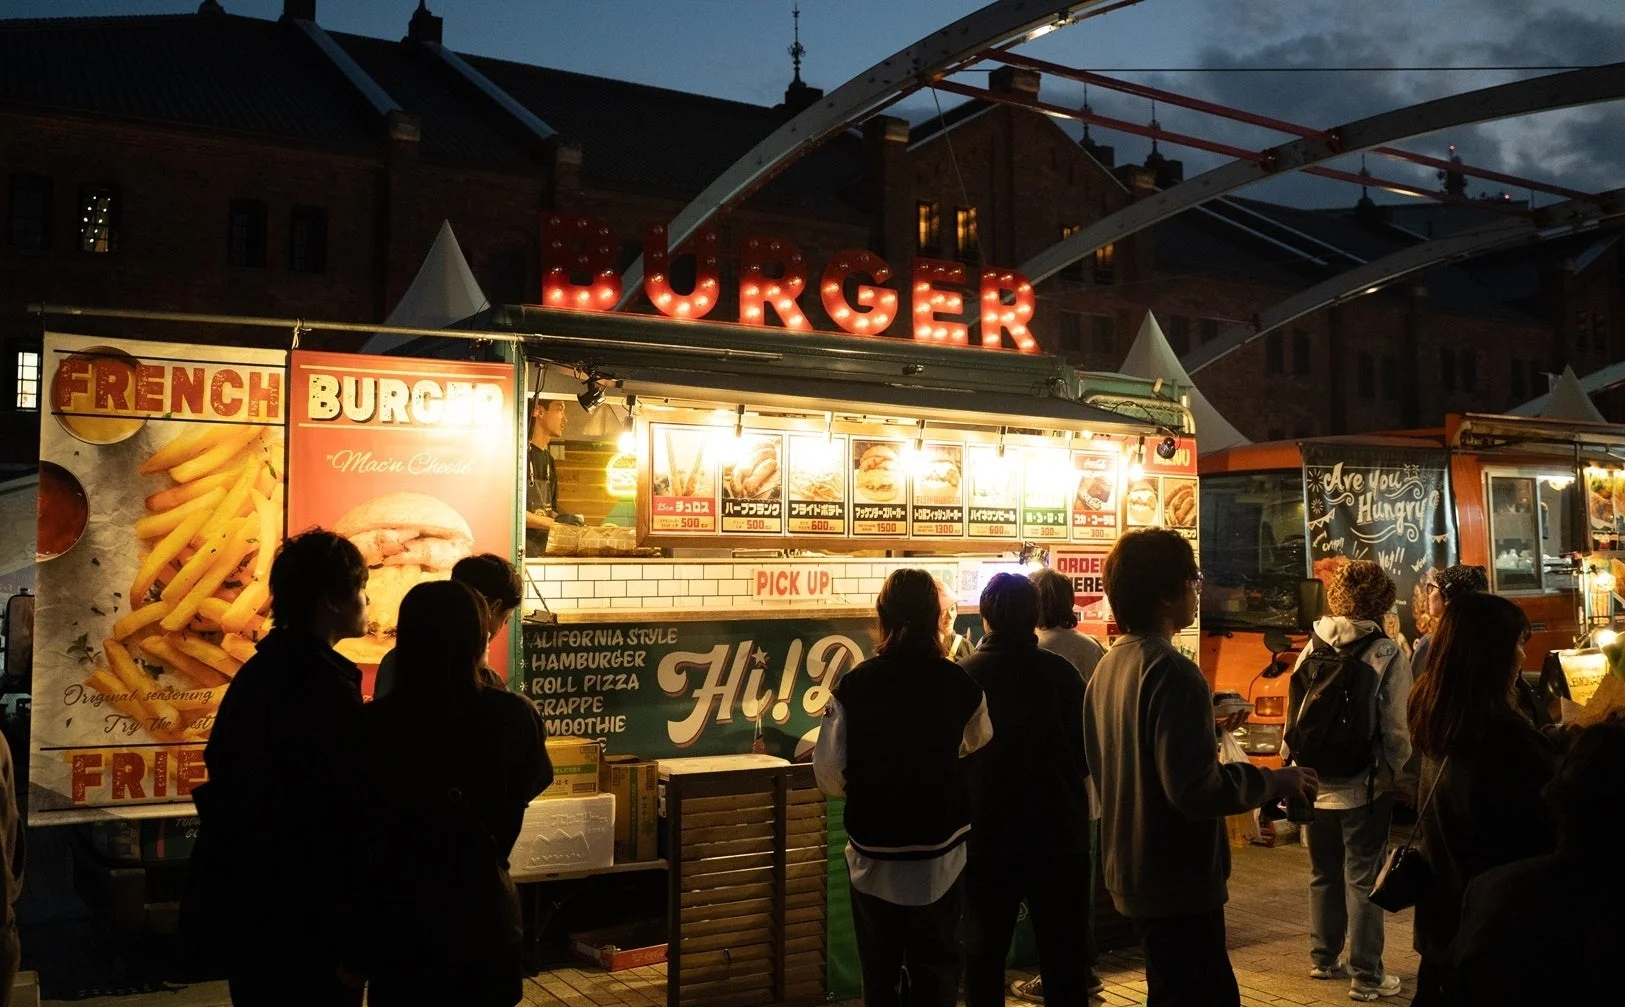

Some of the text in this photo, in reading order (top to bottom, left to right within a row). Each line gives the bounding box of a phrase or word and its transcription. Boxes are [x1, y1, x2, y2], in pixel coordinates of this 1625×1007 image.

[541, 213, 1040, 354] BURGER
[56, 357, 281, 418] FRENCH
[308, 373, 504, 424] BURGER
[1323, 461, 1402, 500] Are you
[675, 500, 710, 513] チュロス
[791, 503, 843, 516] フライドポテト
[681, 517, 700, 528] 500
[746, 519, 765, 530] 500
[811, 520, 829, 531] 600
[876, 522, 897, 533] 1500
[934, 524, 954, 534] 1300
[989, 525, 1005, 535] 600
[1040, 527, 1055, 536] 300
[756, 569, 830, 596] PICK UP
[1070, 577, 1104, 593] ERE
[627, 628, 678, 645] STYLE
[531, 650, 646, 671] HAMBURGER
[531, 673, 640, 695] ROLL PIZZA
[63, 684, 215, 708] Original seasoning
[104, 714, 141, 735] Try
[148, 714, 174, 730] the
[544, 715, 627, 736] MOOTHIE
